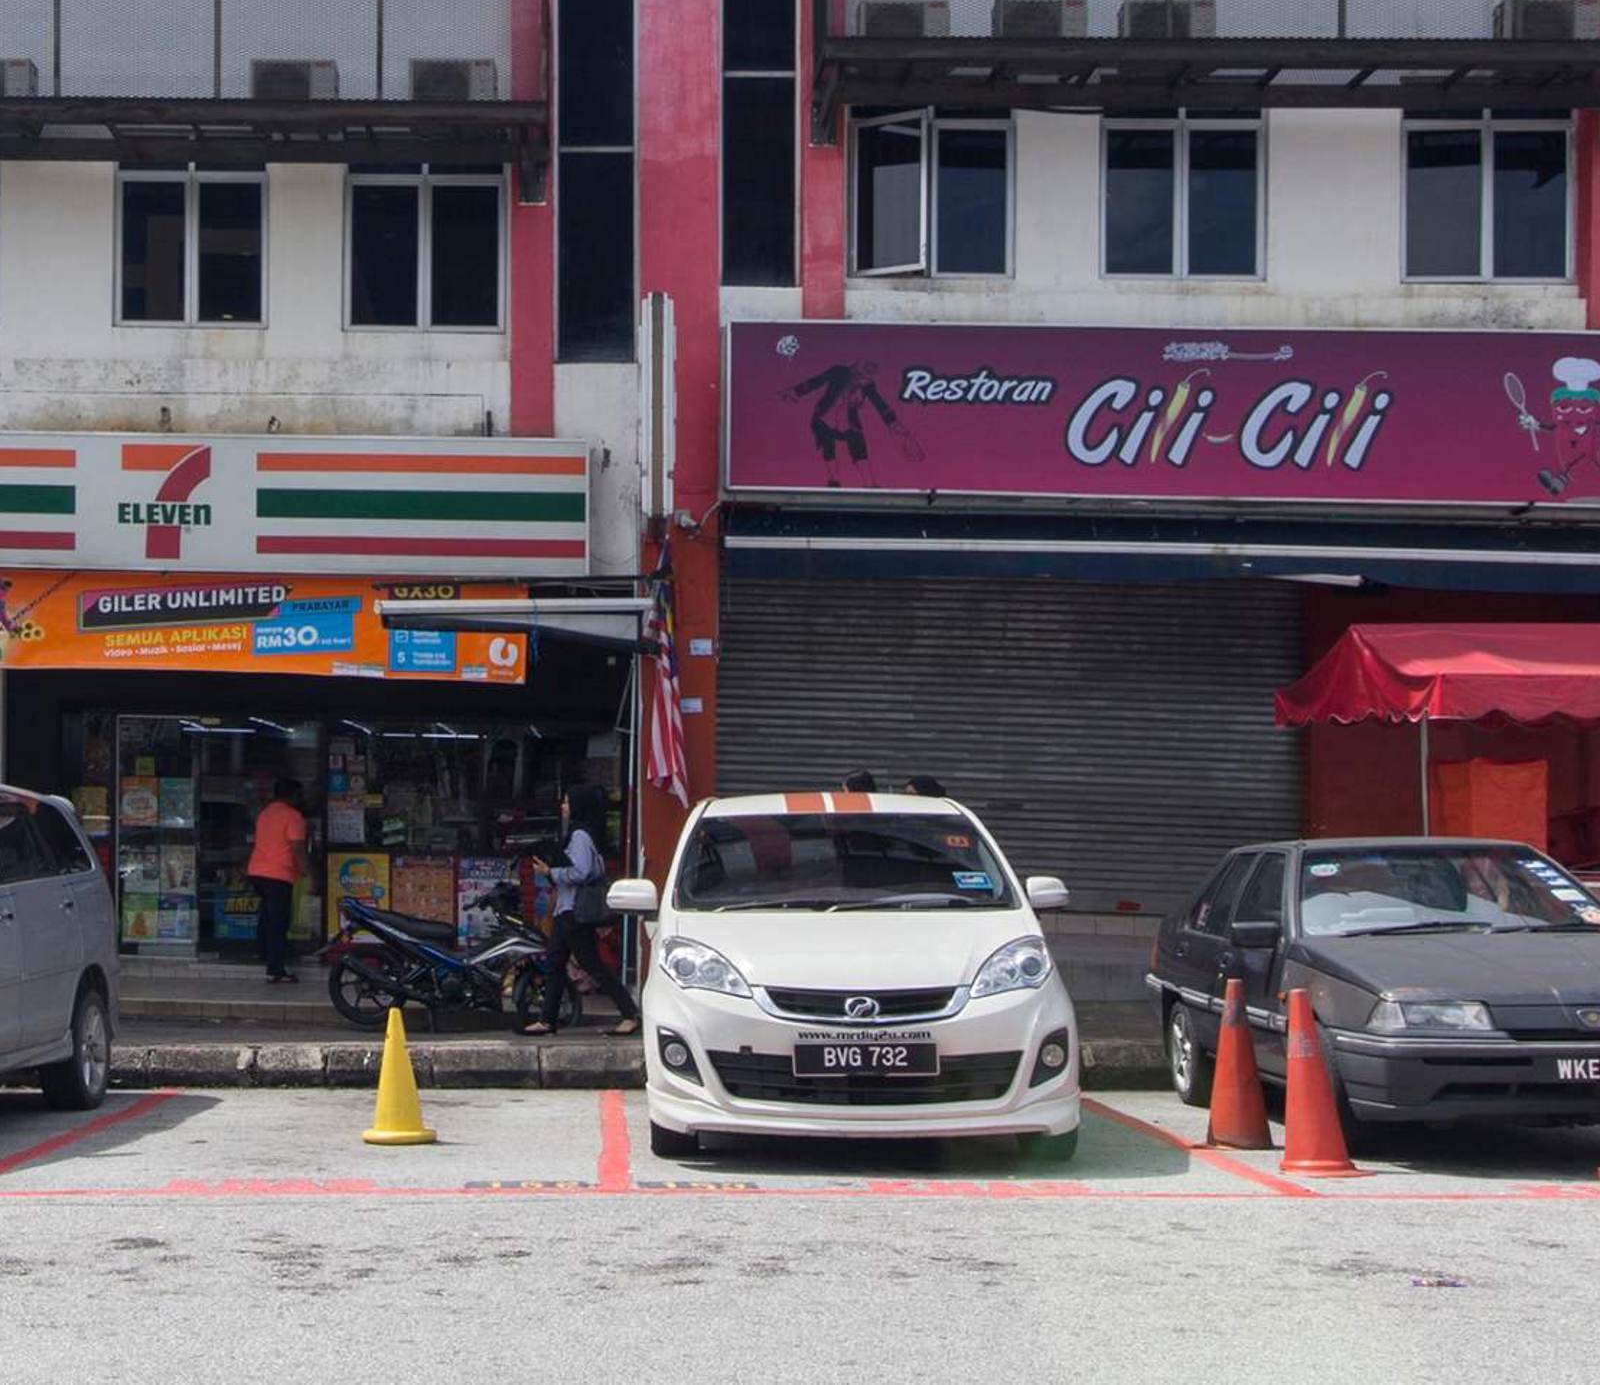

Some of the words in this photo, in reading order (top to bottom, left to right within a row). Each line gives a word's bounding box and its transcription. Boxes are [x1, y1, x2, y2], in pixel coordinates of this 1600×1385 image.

[902, 370, 1053, 403] Restoran
[121, 443, 211, 559] 7
[98, 594, 160, 613] GILER
[166, 586, 286, 609] UNLIMITED
[104, 633, 163, 648] SEMUA
[169, 626, 247, 644] APLIKASI
[256, 625, 319, 649] RM30
[824, 1046, 862, 1067] BVG
[869, 1046, 908, 1067] 732
[1557, 1059, 1600, 1080] WKE
